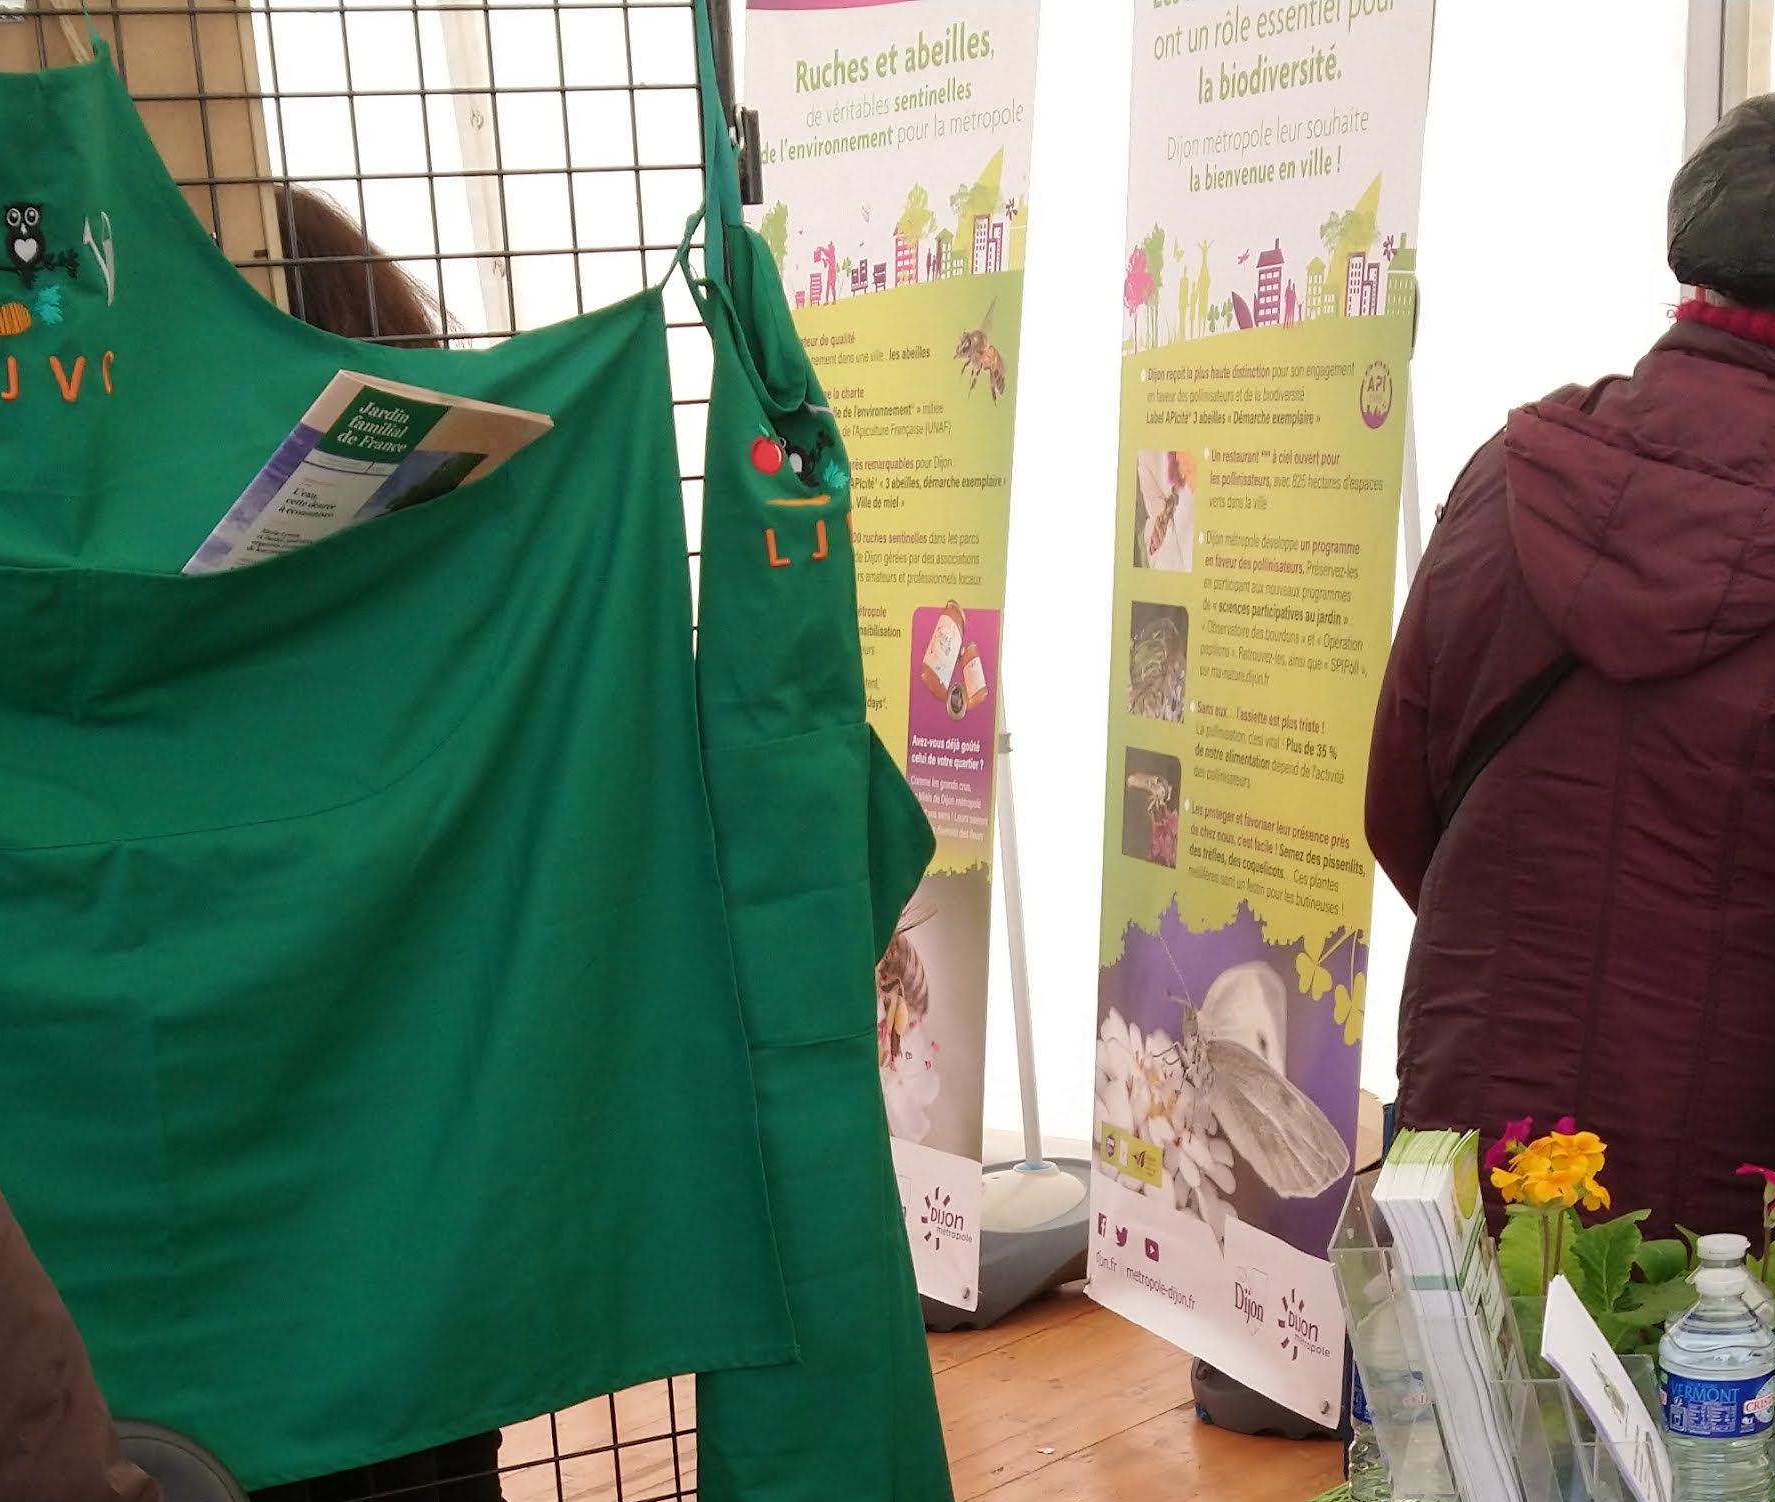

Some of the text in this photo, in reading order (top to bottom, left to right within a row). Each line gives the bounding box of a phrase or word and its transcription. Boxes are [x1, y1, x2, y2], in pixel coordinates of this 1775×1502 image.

[1154, 25, 1183, 60] ont
[1188, 25, 1209, 54] un
[1215, 4, 1251, 48] rôle
[1257, 0, 1341, 39] essentiel
[796, 21, 995, 93] Ruches et abeilles,
[1199, 43, 1342, 104] la biodiversité.
[806, 77, 972, 128] de véritables sentinelles
[761, 97, 1024, 164] de l'environnement pour la métropole
[1167, 106, 1369, 166] Dijon métropole leur souhaite
[1189, 147, 1332, 192] la bienvenue en ville
[348, 415, 409, 439] familial
[359, 401, 410, 424] Jardin
[337, 430, 407, 454] de France
[1234, 1281, 1264, 1324] Dijon
[1672, 1383, 1740, 1402] VERMONT
